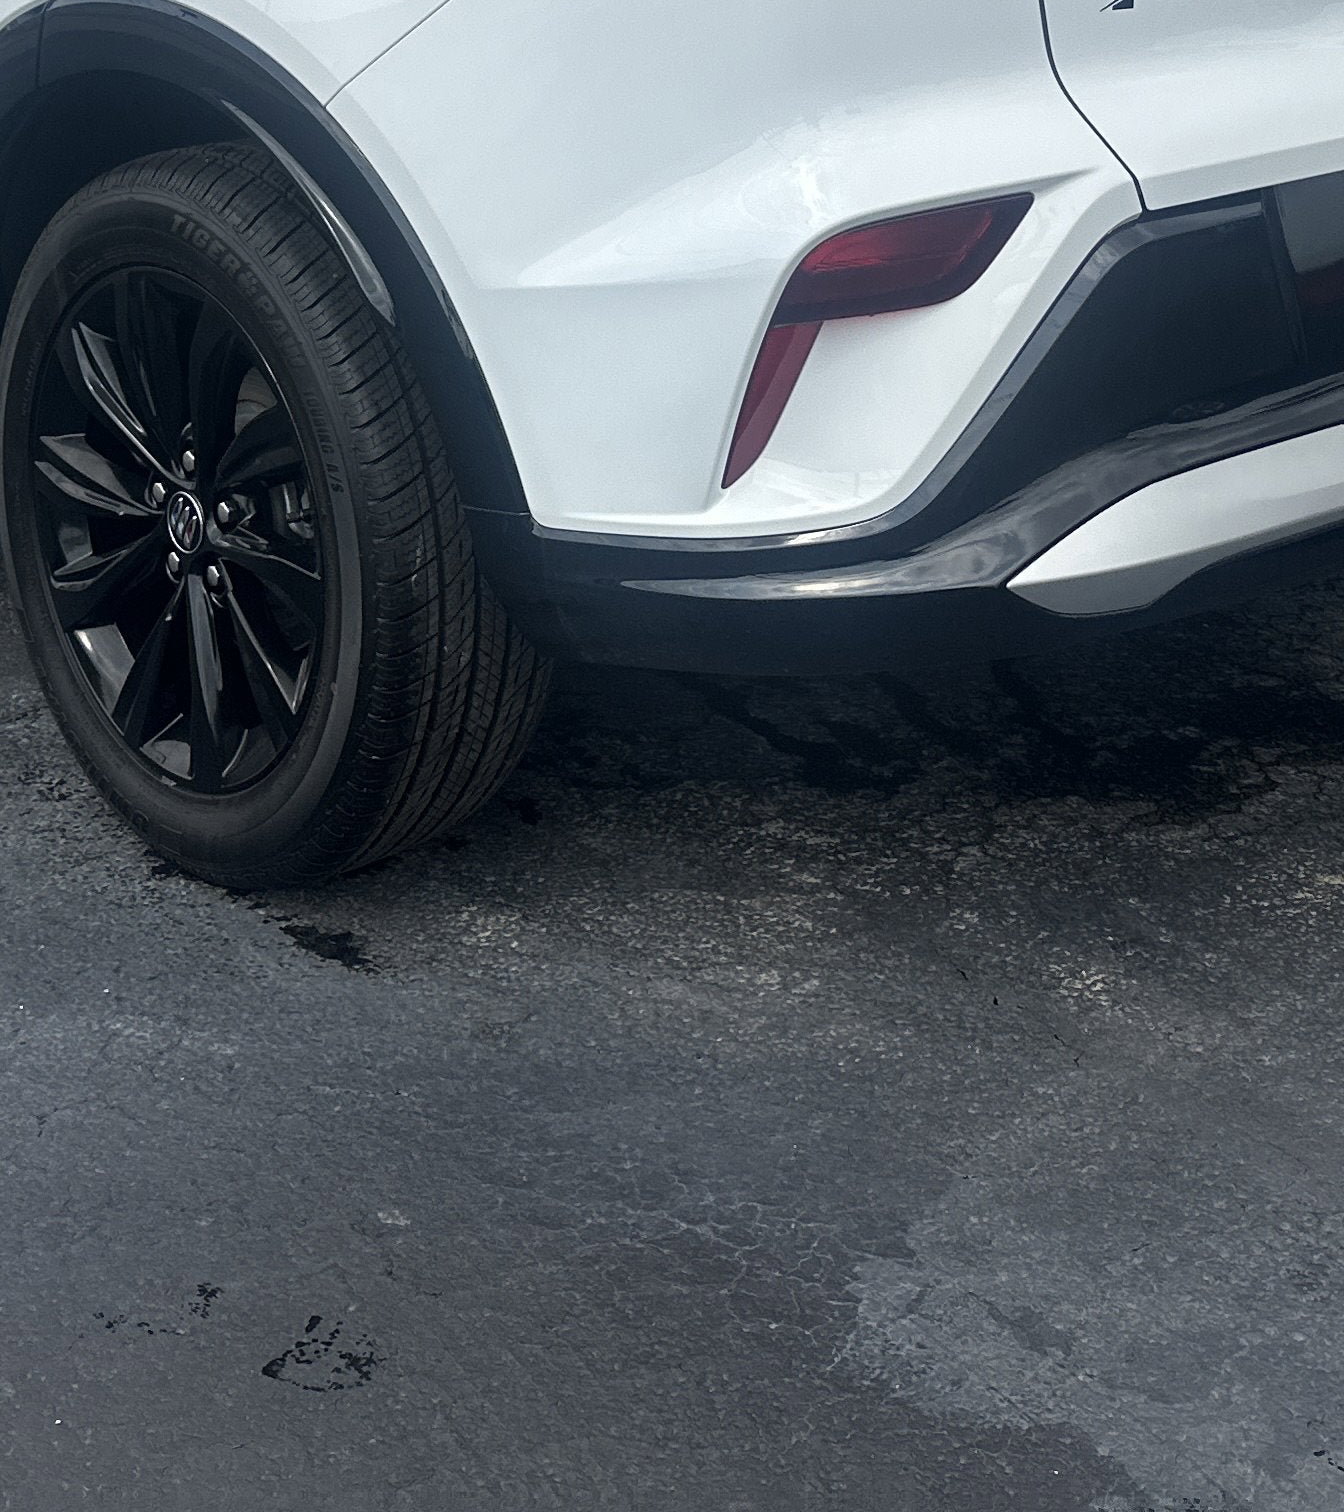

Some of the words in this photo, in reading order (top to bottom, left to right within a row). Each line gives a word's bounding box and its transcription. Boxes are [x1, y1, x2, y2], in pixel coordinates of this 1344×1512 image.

[171, 214, 241, 274] TIGER
[256, 294, 308, 368] PAW
[326, 462, 345, 493] A/S
